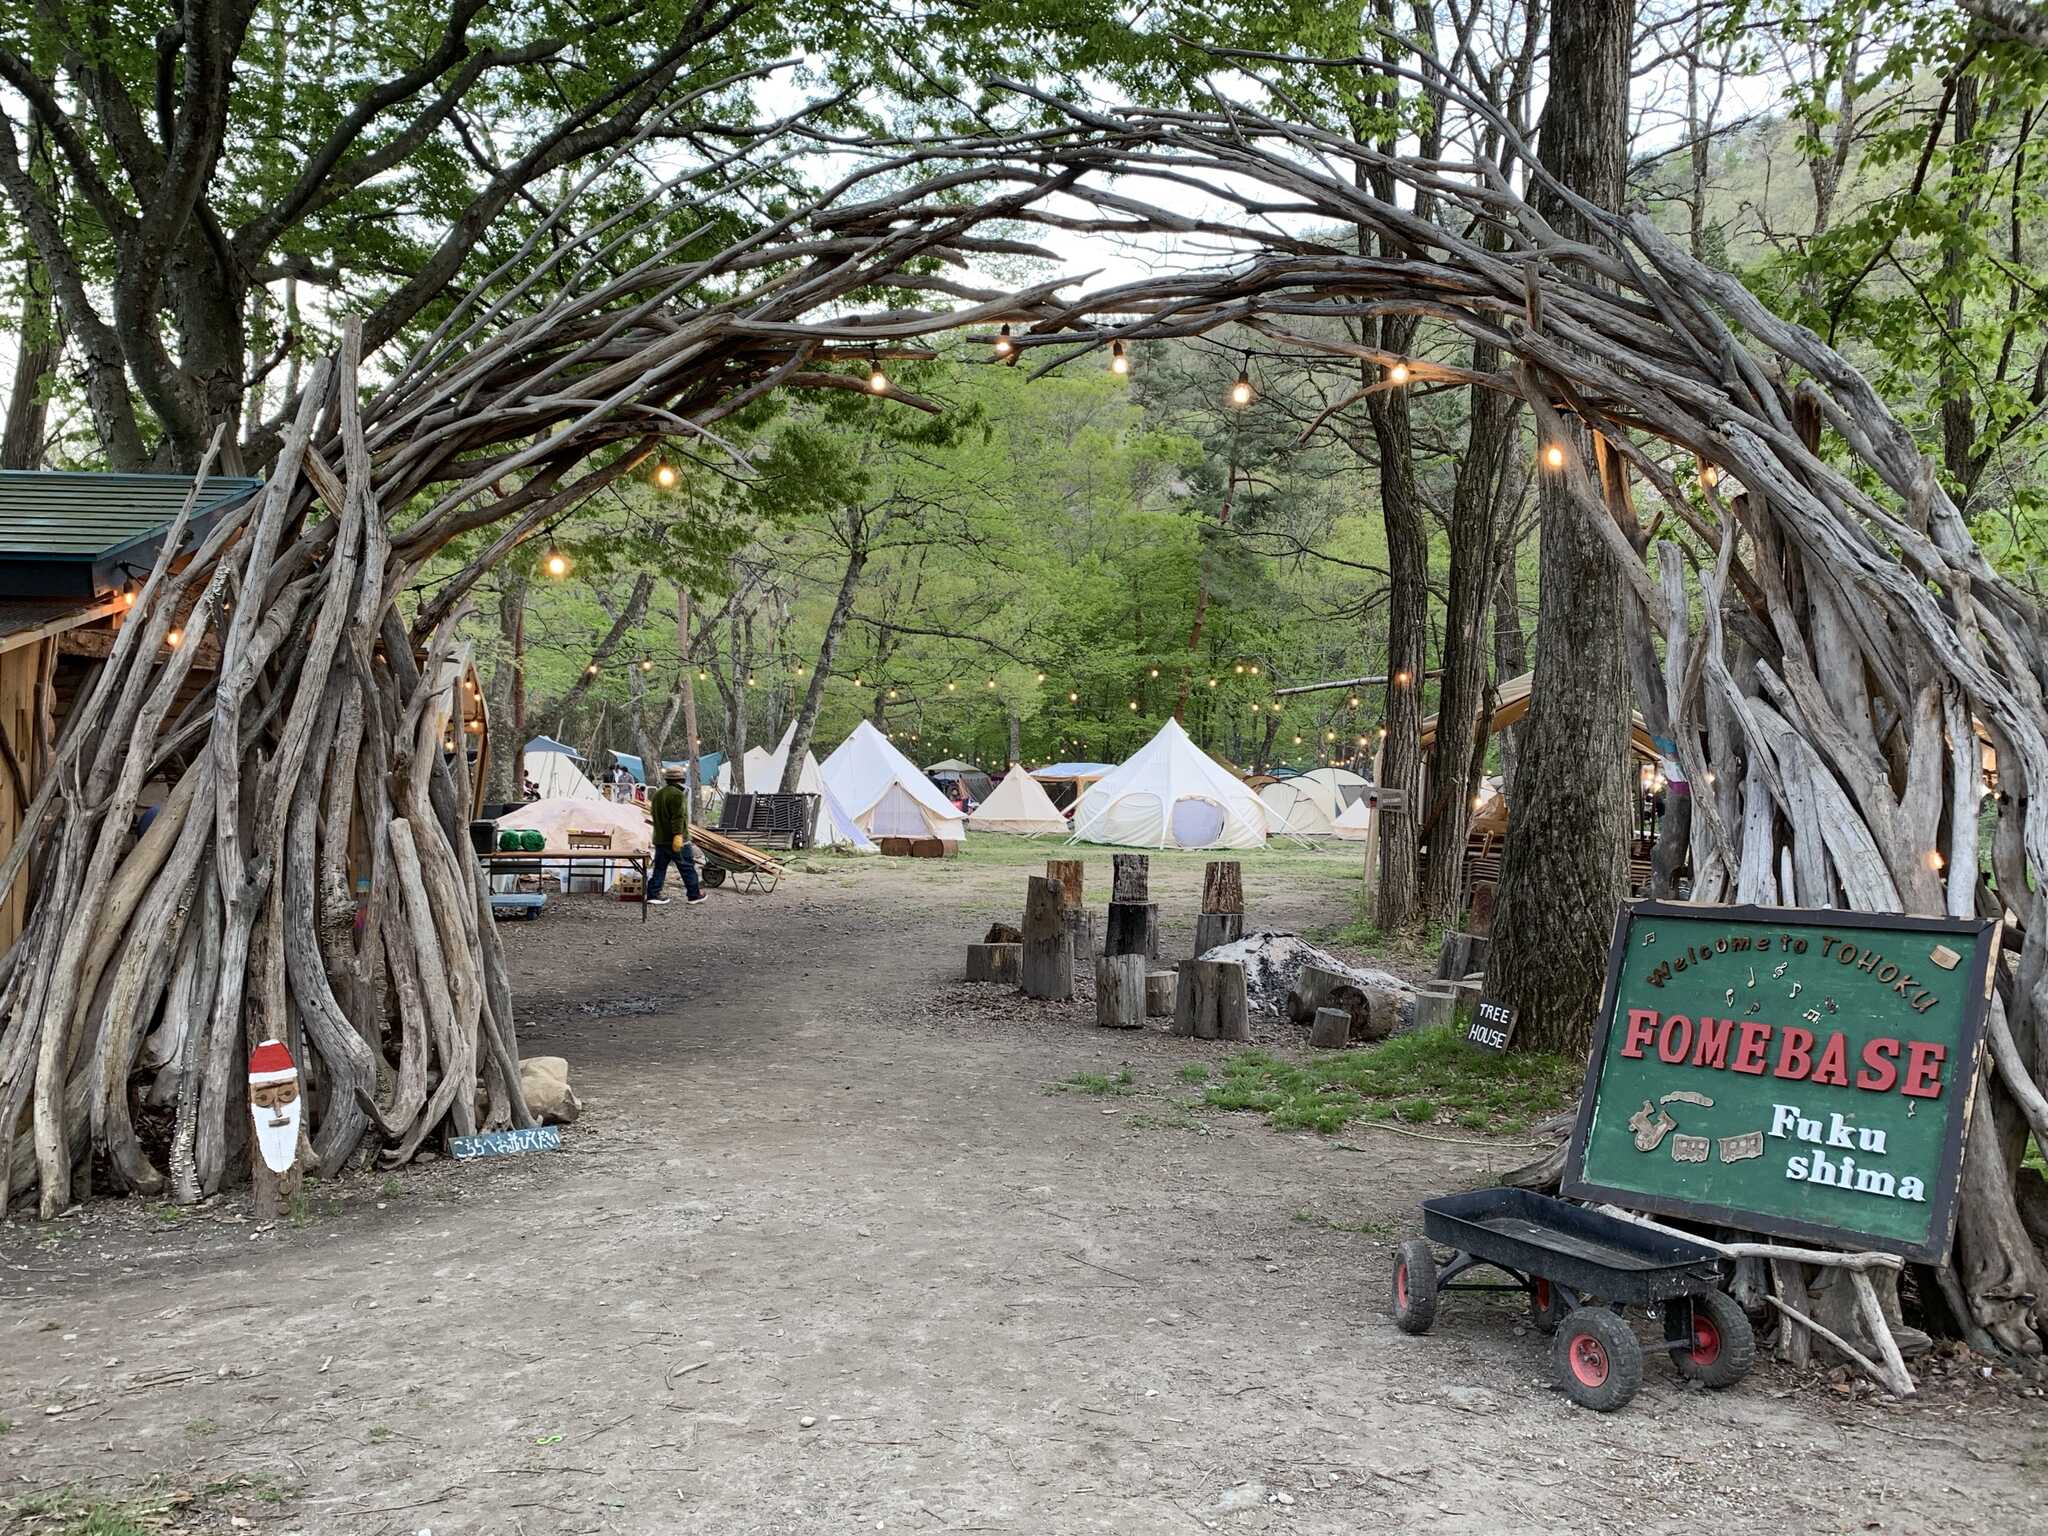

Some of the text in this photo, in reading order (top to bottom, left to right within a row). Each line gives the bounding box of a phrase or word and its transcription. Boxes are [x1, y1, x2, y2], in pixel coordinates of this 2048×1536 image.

[1647, 934, 1940, 1014] Welcome to TOHOKU
[1468, 1023, 1507, 1049] HOUSE
[1480, 1003, 1510, 1024] TREE
[1620, 1008, 1946, 1099] FOMEBASE
[1767, 1103, 1888, 1155] Fuku
[1785, 1149, 1927, 1202] shima
